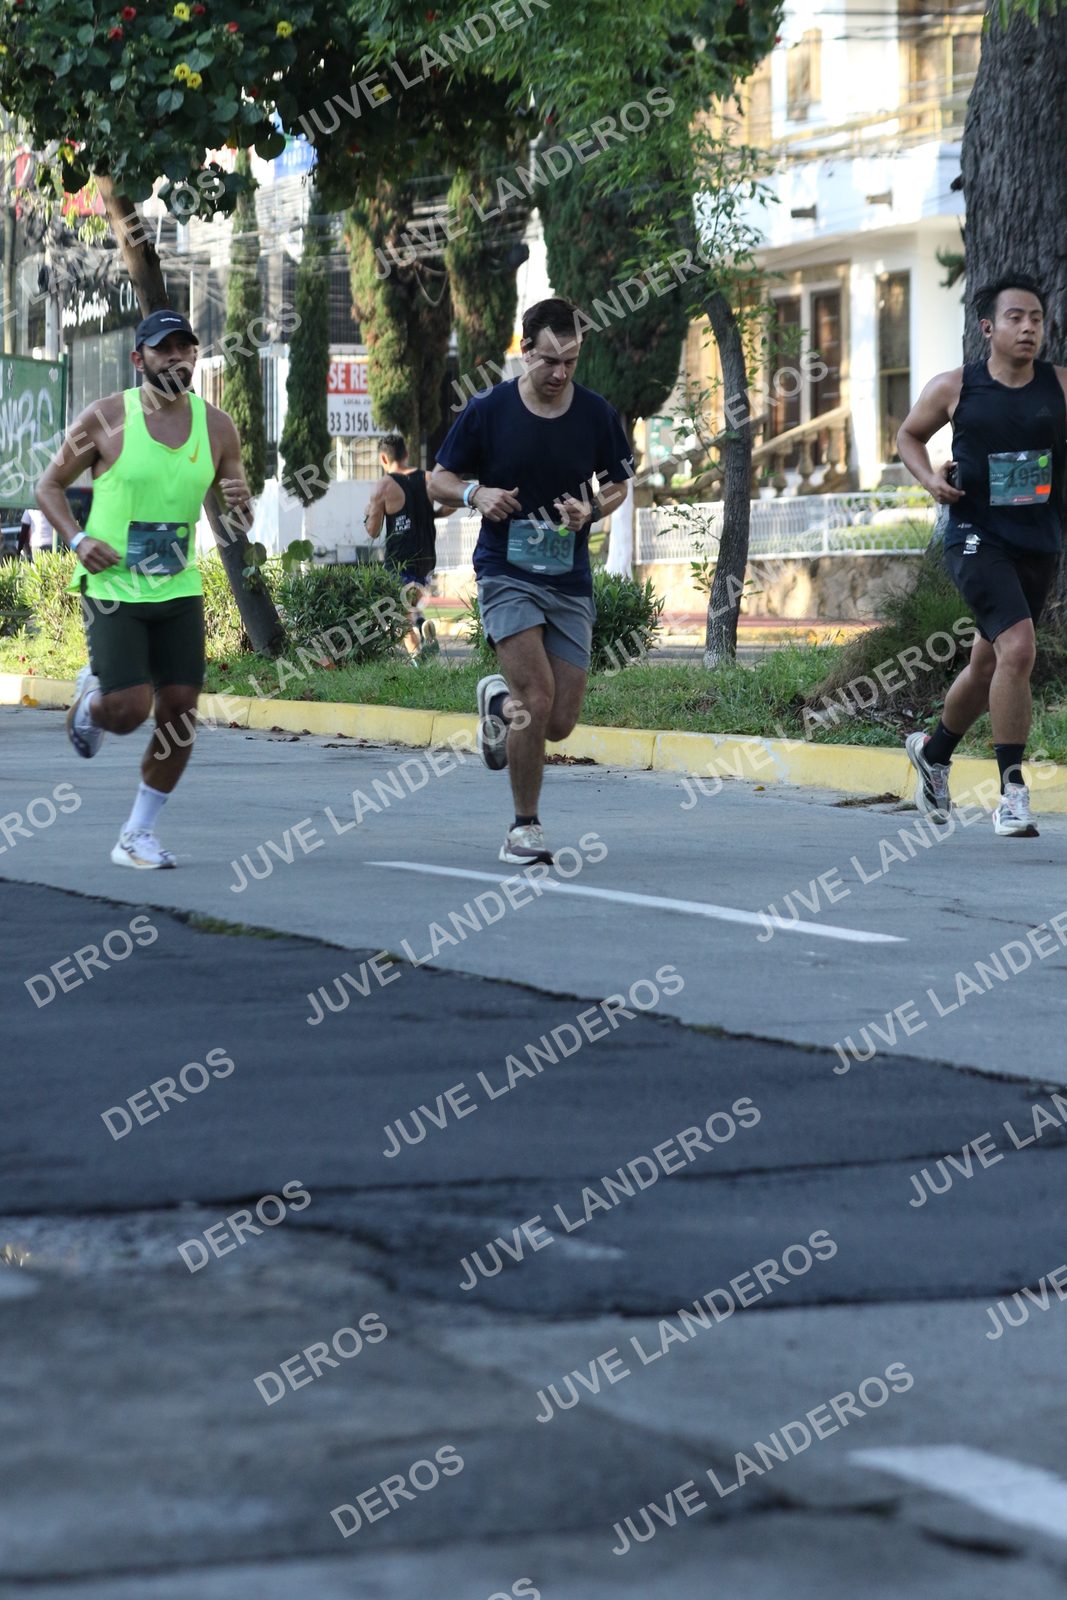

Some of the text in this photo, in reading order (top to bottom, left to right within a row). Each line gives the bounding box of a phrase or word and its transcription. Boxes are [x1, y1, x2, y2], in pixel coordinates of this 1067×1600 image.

[329, 362, 346, 391] SE
[330, 411, 341, 432] 33
[345, 411, 369, 432] 3156
